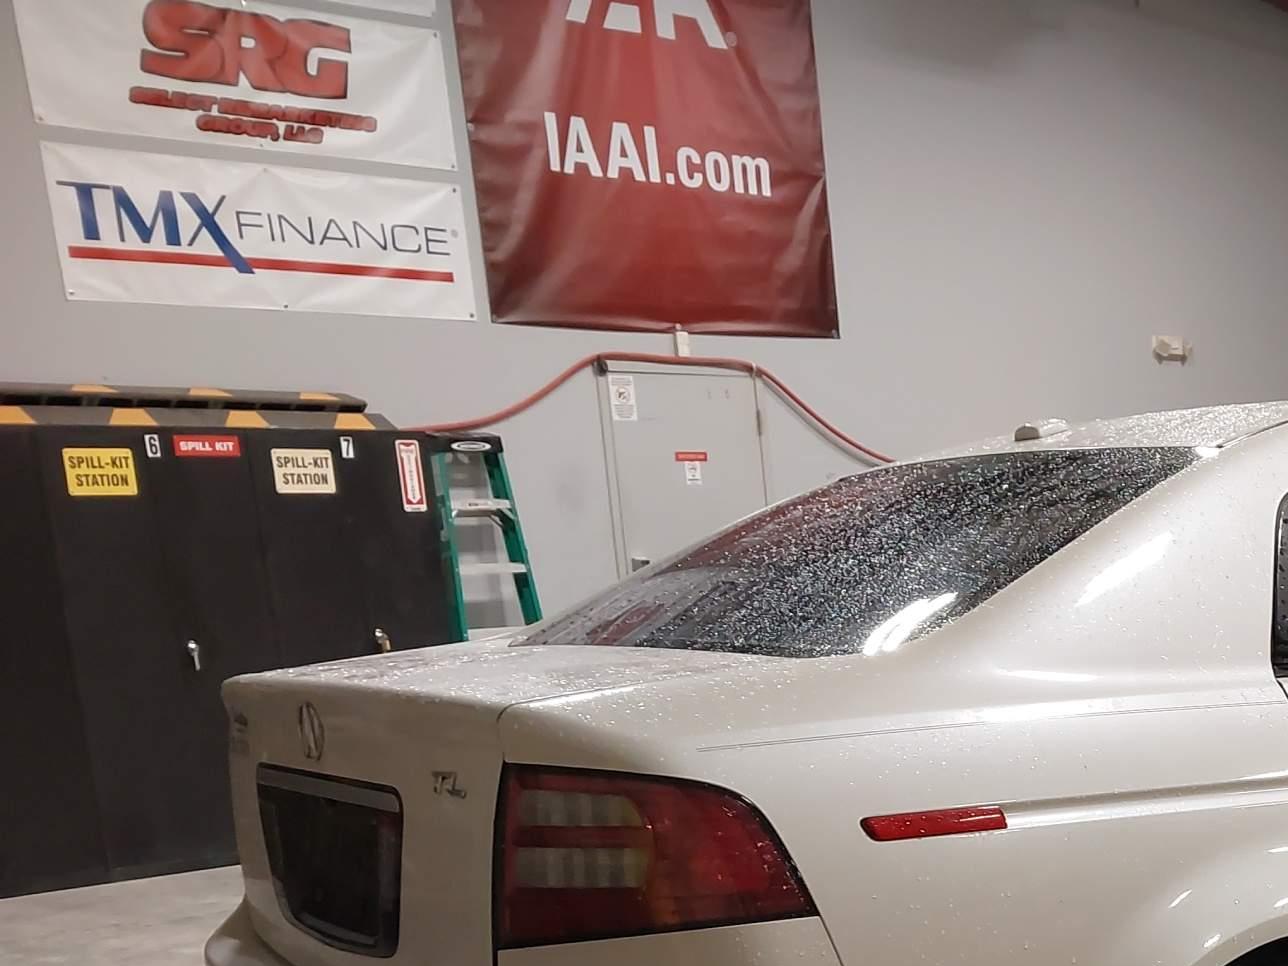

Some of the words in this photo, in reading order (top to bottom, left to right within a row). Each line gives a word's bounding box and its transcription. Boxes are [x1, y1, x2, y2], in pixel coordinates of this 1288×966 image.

[140, 0, 352, 99] SRG
[543, 111, 772, 197] IAAI.com
[149, 436, 159, 455] 6
[179, 440, 213, 451] SPILL
[214, 441, 235, 451] KIT
[342, 438, 351, 457] 7
[68, 455, 130, 469] SPILL-KIT
[276, 455, 329, 469] SPILL-KIT
[75, 473, 129, 487] STATION
[282, 472, 328, 485] STATION
[431, 770, 467, 800] TL
